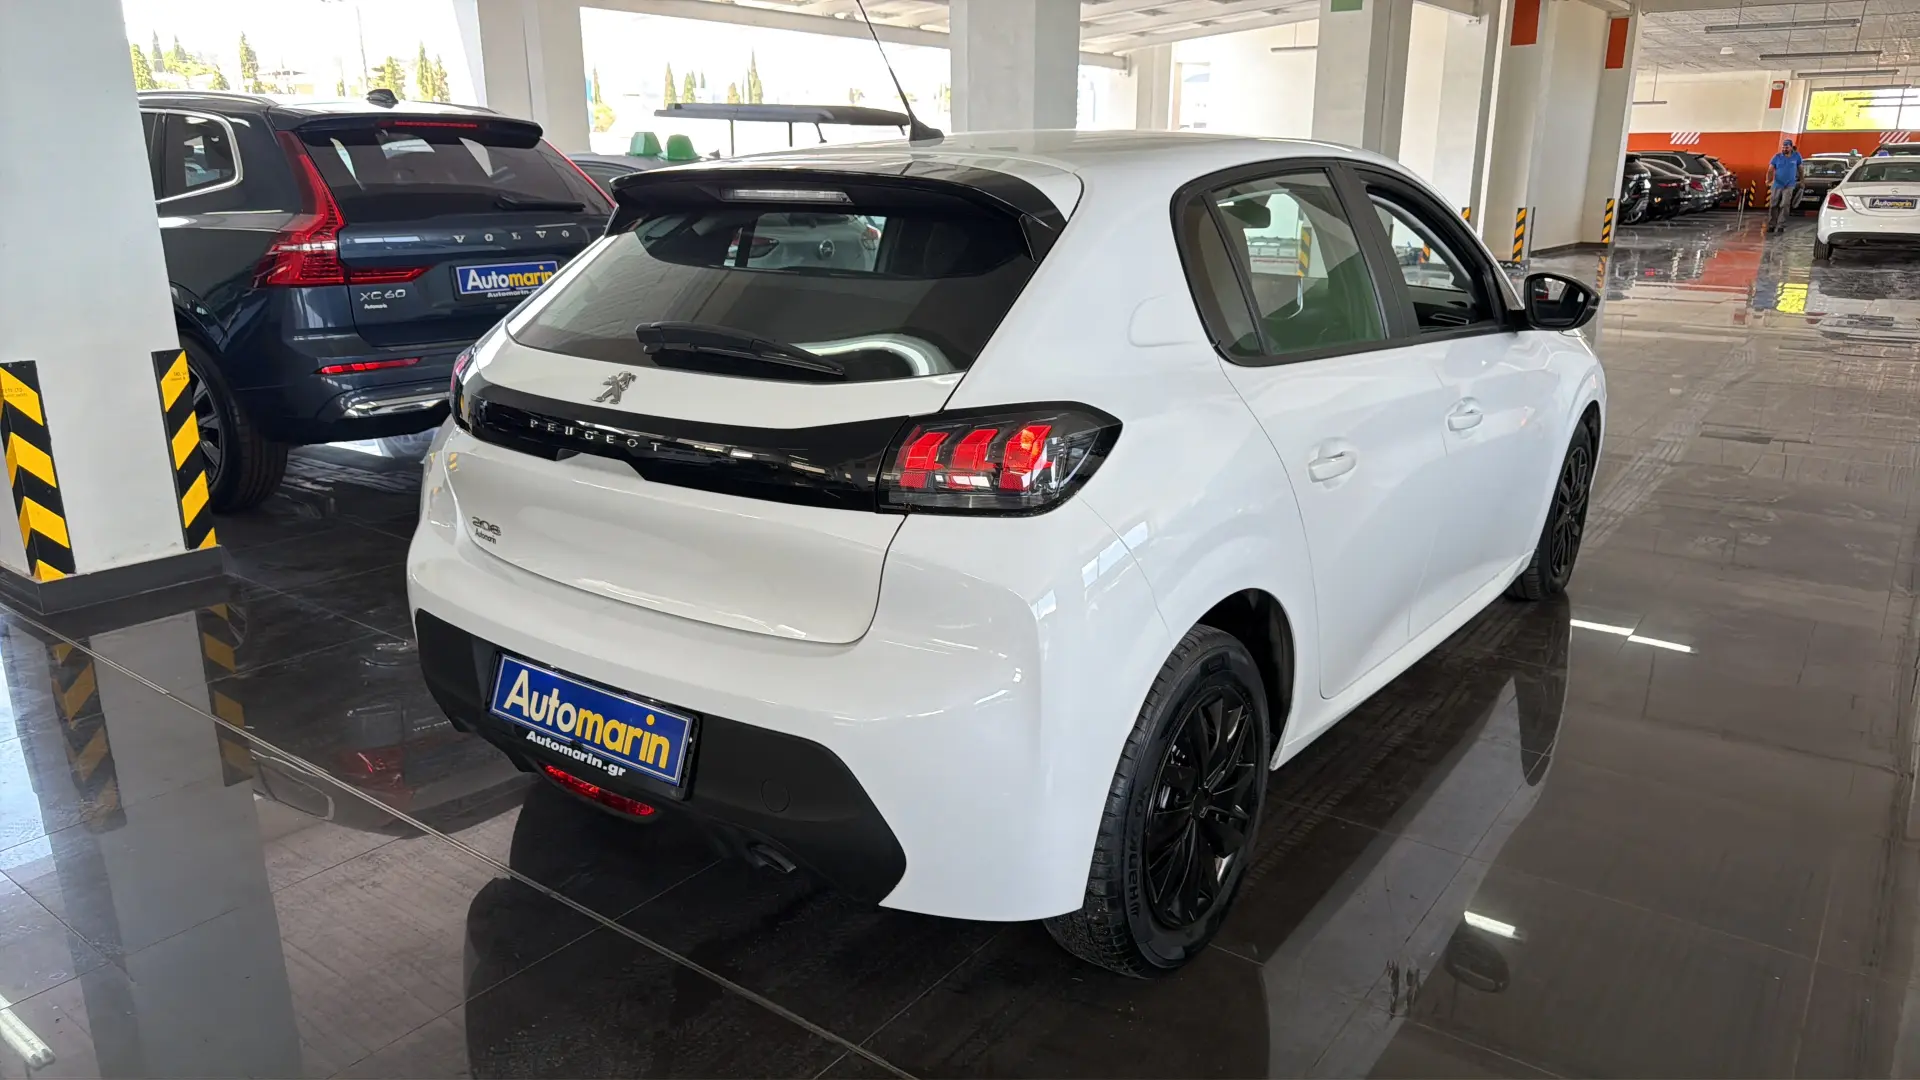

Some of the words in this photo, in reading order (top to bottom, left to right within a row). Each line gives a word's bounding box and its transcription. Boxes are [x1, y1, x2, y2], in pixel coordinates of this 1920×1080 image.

[453, 229, 570, 243] VOLVO
[360, 289, 406, 301] XC60
[530, 419, 661, 452] PEUGEOT
[472, 516, 502, 536] 208
[504, 668, 670, 769] Automarin
[526, 730, 627, 777] Automarin.gr
